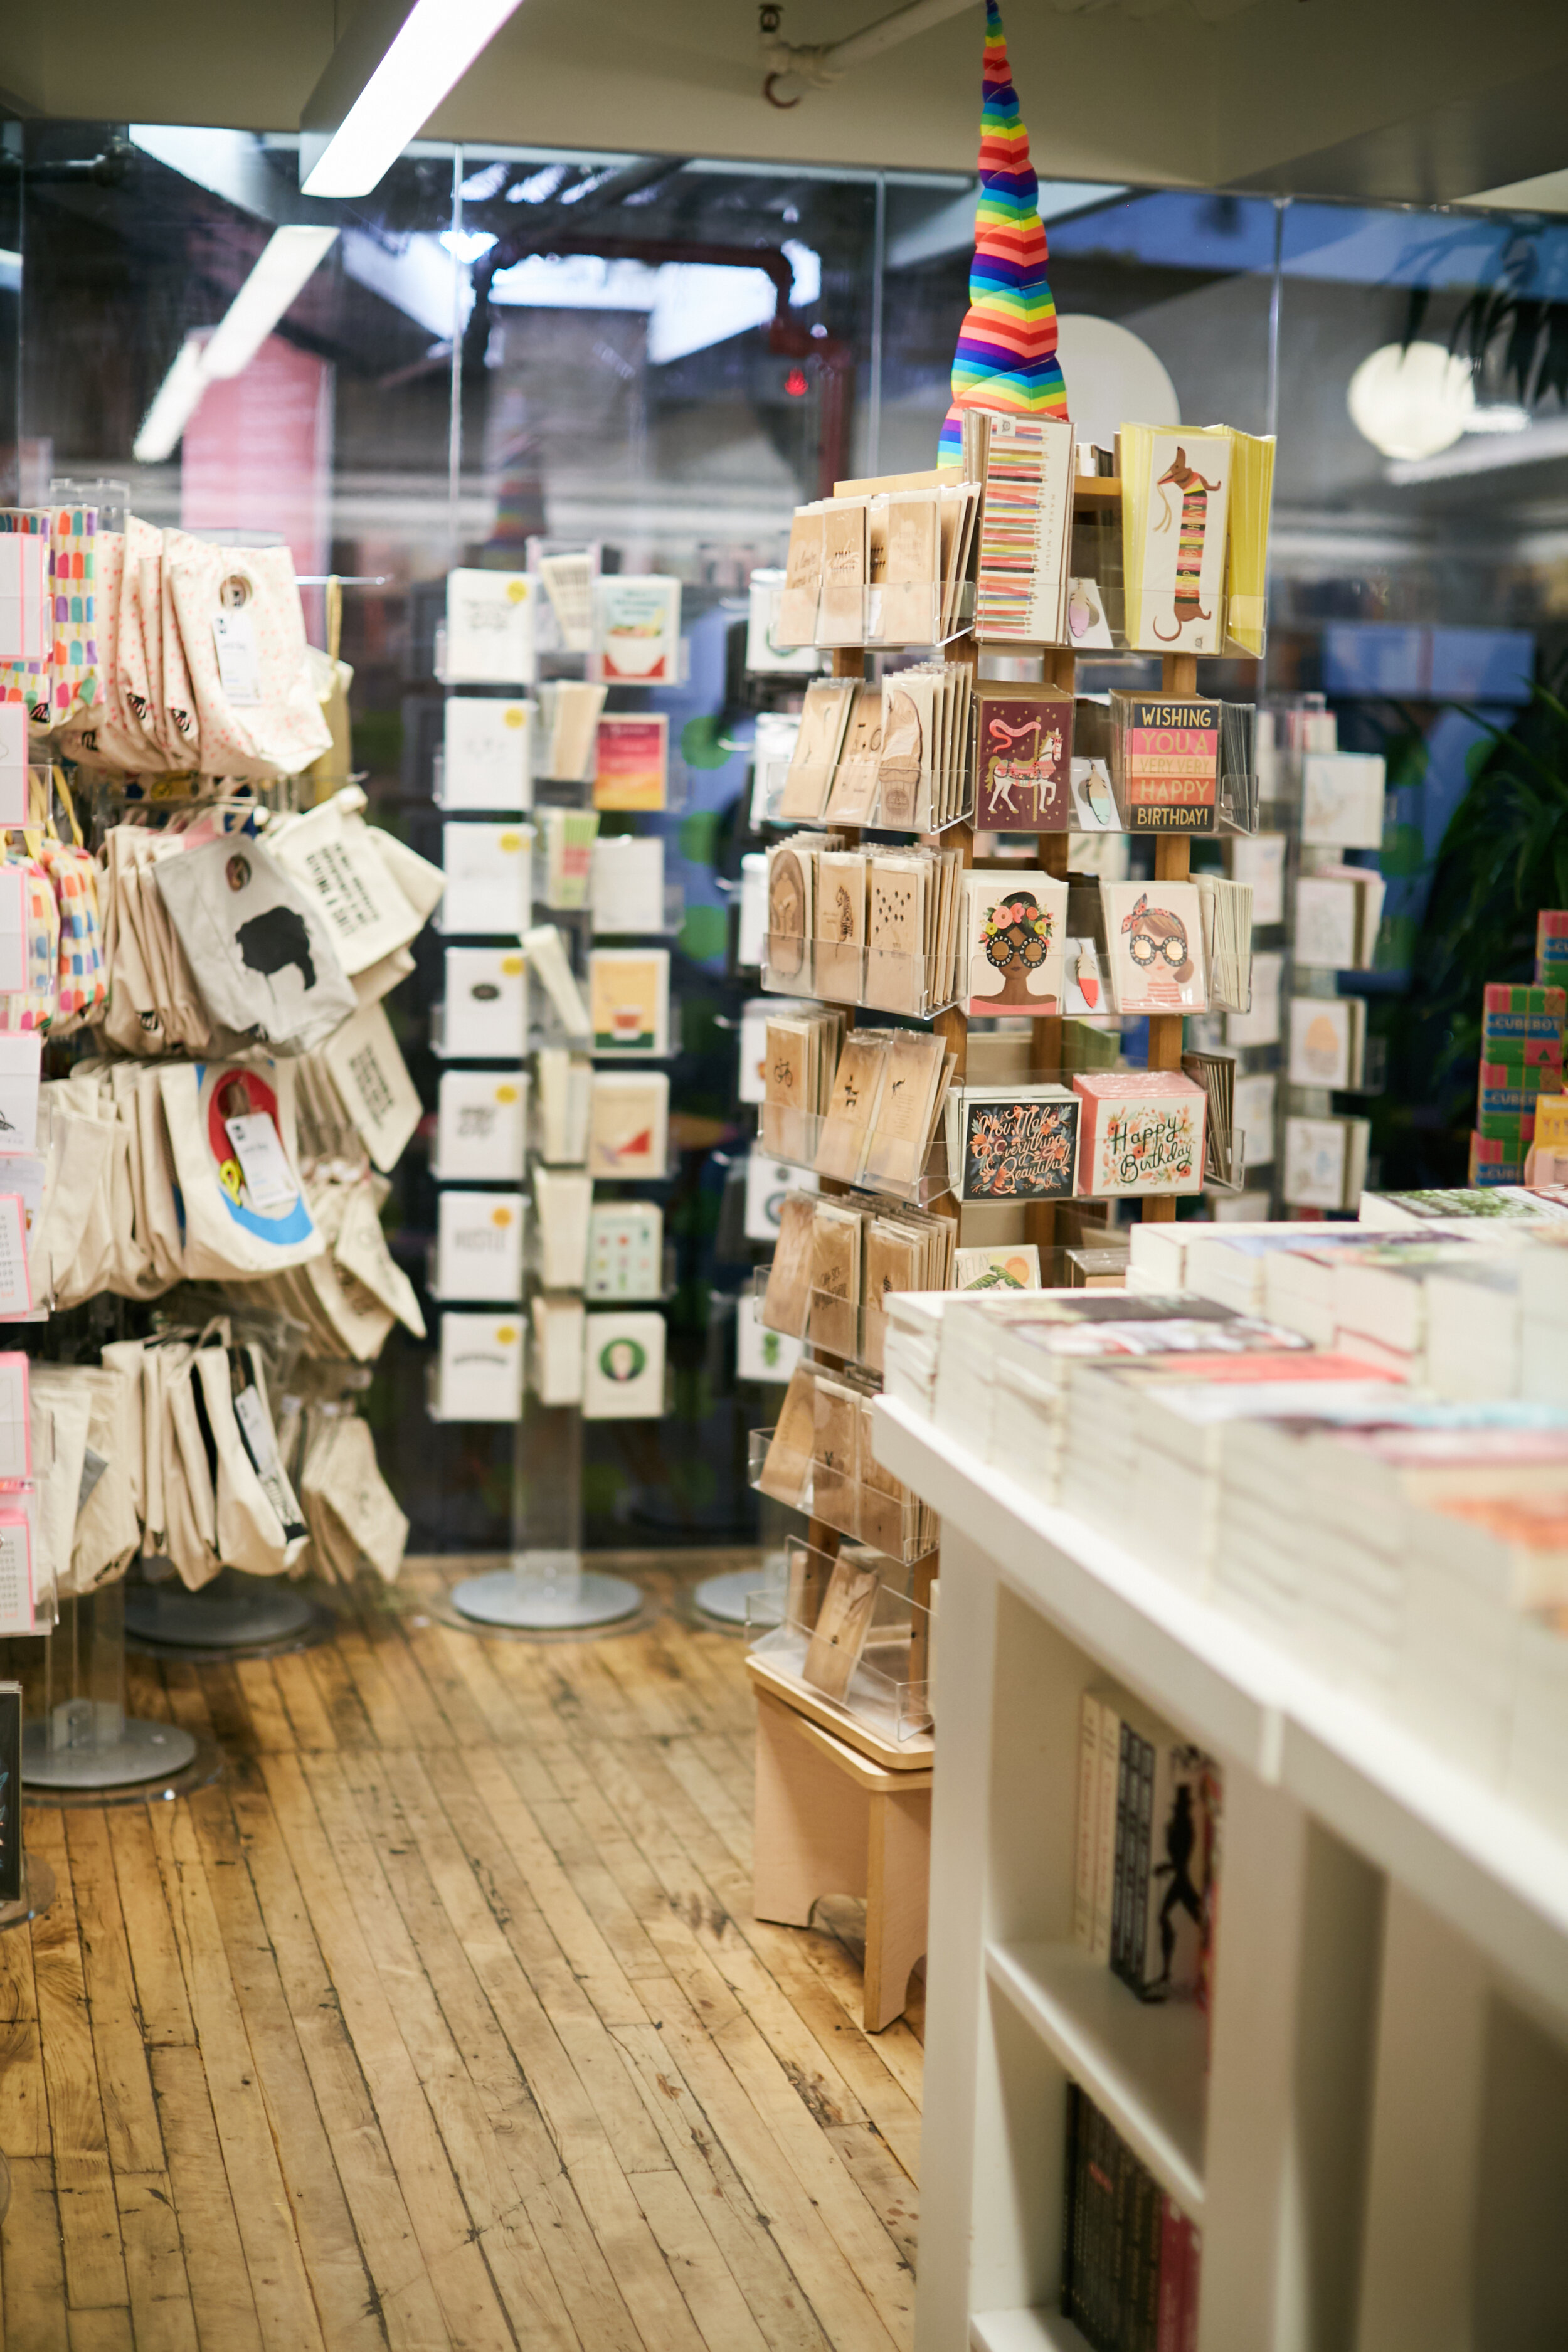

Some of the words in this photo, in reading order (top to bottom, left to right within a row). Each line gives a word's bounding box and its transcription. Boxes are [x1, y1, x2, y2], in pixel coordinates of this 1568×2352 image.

[1184, 499, 1203, 557] BIRTHDAY!
[1181, 564, 1196, 597] HAPPY
[1142, 707, 1212, 728] WISHING
[1142, 731, 1190, 754] YOU
[1194, 733, 1209, 755] A
[1140, 757, 1172, 774] VERY
[1177, 758, 1210, 774] VERY
[1140, 780, 1210, 802] HAPPY
[1137, 807, 1208, 825] BIRTHDAY!
[989, 936, 1012, 946] HAPPY
[1020, 938, 1046, 955] BIRTHDAY
[1131, 935, 1153, 945] HAPPY
[1162, 936, 1187, 953] BIRTHDAY
[987, 949, 1014, 966] BIRTHDAY
[1023, 958, 1043, 967] GIRL!
[1130, 948, 1155, 965] BIRTHDAY
[1495, 1016, 1560, 1031] CUBEBOT
[975, 1115, 1012, 1158] You
[1005, 1106, 1059, 1138] Make
[1111, 1116, 1185, 1155] Happy
[986, 1131, 1062, 1170] Everything
[993, 1143, 1071, 1194] Beautiful
[1120, 1142, 1192, 1183] Birthday
[955, 1254, 990, 1288] RELAX
